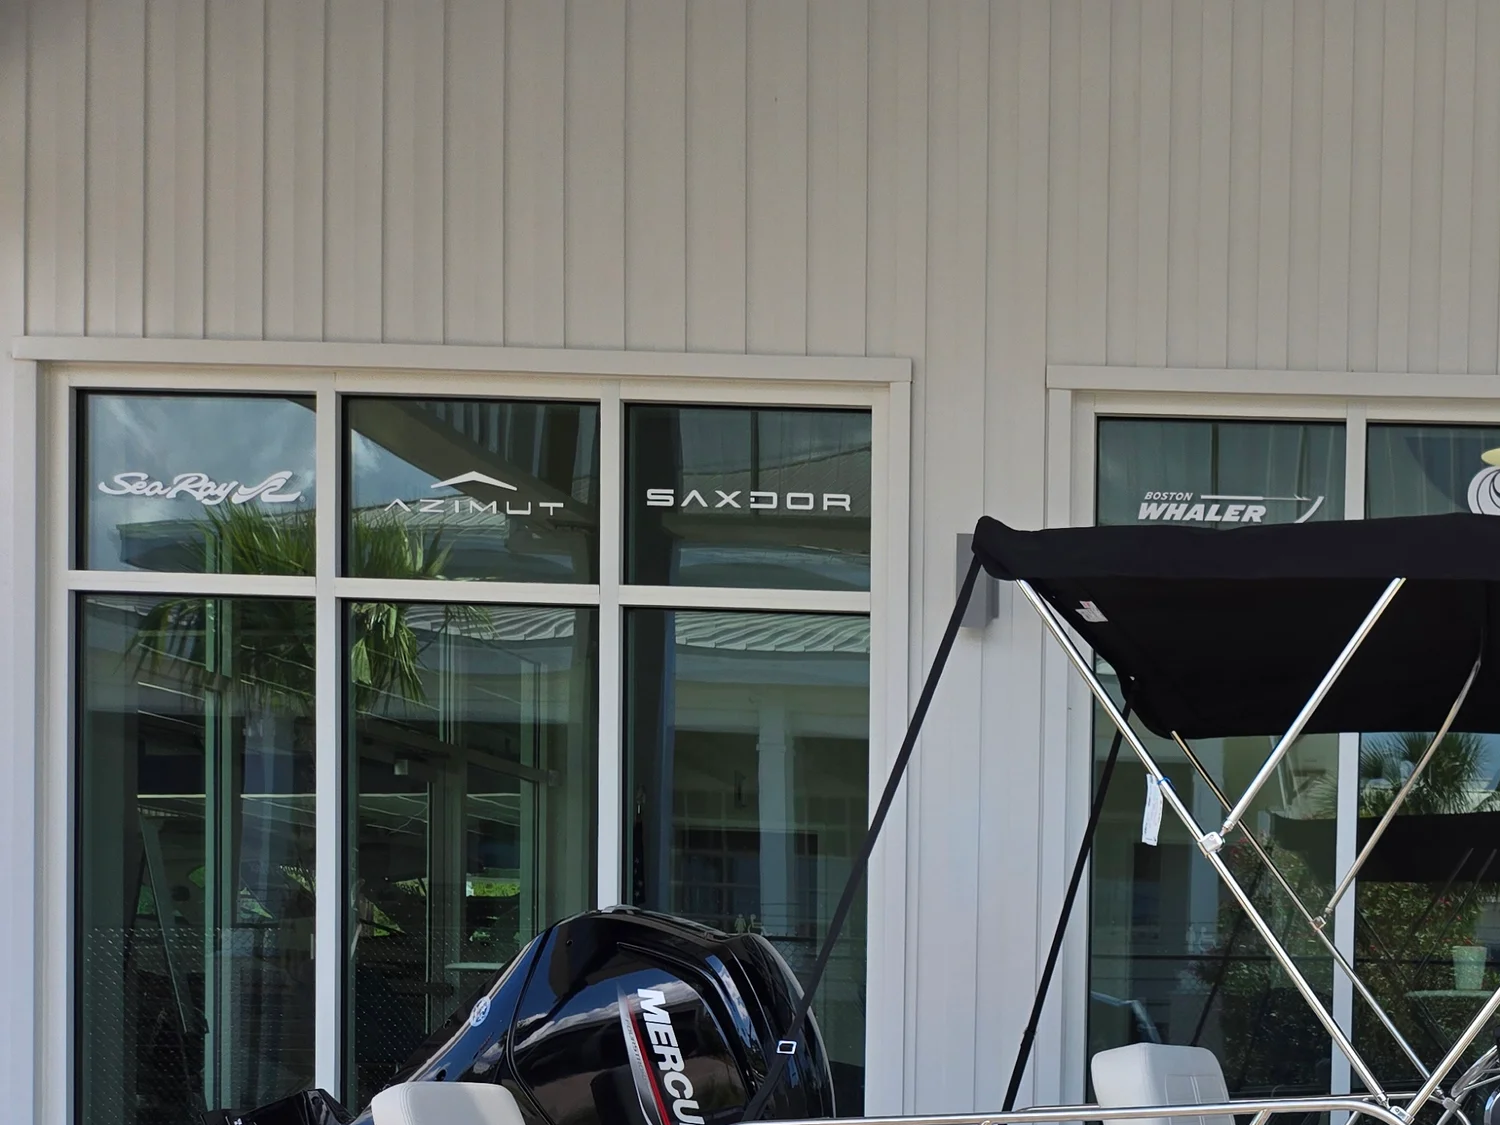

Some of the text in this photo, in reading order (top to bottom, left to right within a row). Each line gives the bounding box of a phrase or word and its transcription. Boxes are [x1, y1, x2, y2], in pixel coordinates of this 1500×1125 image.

[98, 472, 239, 505] Sea Ray
[1144, 491, 1194, 501] BOSTON
[384, 498, 564, 516] AZIMUT
[646, 488, 851, 512] SAXDOR
[1137, 502, 1267, 523] WHALER
